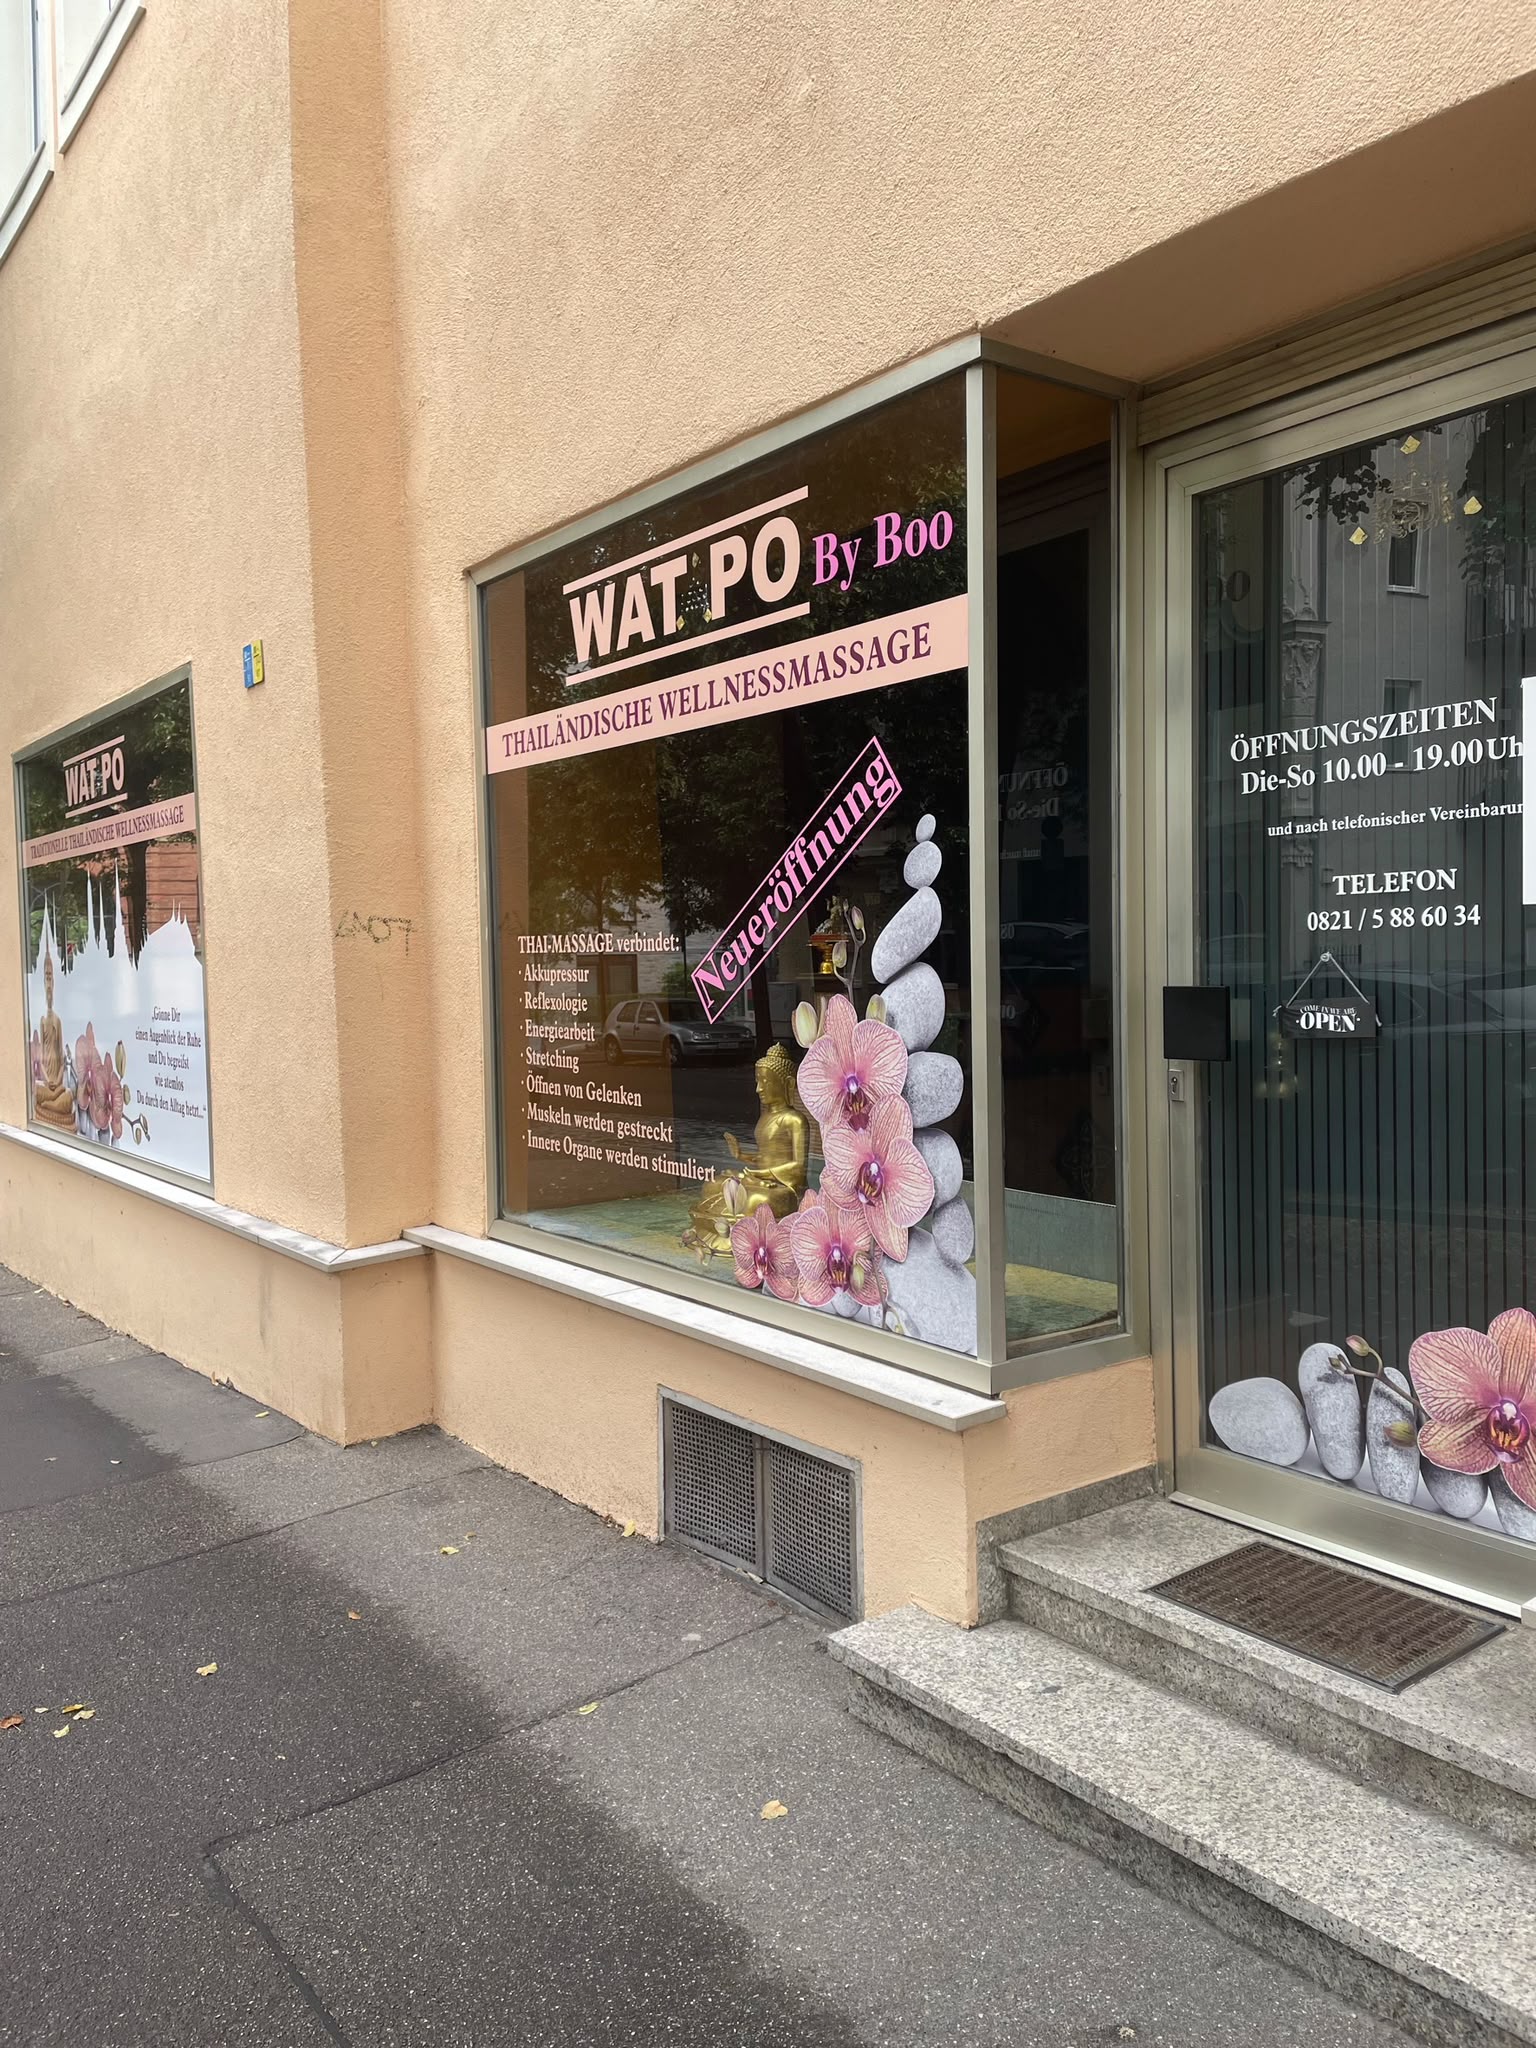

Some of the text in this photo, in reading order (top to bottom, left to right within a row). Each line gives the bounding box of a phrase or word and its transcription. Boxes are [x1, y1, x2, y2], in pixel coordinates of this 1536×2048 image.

[569, 510, 954, 664] WAT PO By Boo
[502, 622, 932, 759] THAILÄNDISCHE WELLNESSMASSAGE
[1230, 697, 1497, 762] ÖFFNUNGSZEITEN
[65, 748, 124, 807] WAT PO
[1241, 736, 1523, 795] Die-So 10.00 - 19.00 Uh
[31, 805, 184, 859] TRADITIONELLE THAILÄNDISCHE WELLNESSMASSAGE
[1268, 802, 1523, 837] und nach telefonischer Vereinbaru
[695, 755, 897, 1009] Neueröffnung
[1332, 869, 1458, 896] TELEFON
[1307, 904, 1481, 931] 0821 / 5 88 60 34
[518, 932, 680, 954] THAI-MASSAGE verbindet:
[524, 964, 589, 985] Akkupressur
[171, 1007, 181, 1022] Dir
[524, 992, 588, 1015] Reflexologie
[525, 1018, 596, 1043] Energiearbeit
[1300, 1012, 1356, 1032] OPEN
[135, 1027, 202, 1047] einen Augenblick der Ruhe
[148, 1050, 190, 1070] und Du begreifst
[525, 1046, 580, 1073] Stretching
[155, 1073, 185, 1092] wie atemlos
[526, 1070, 642, 1107] Öffnen von Gelenken
[136, 1090, 145, 1105] Du
[145, 1092, 159, 1109] durch
[159, 1095, 170, 1110] den
[170, 1098, 186, 1118] Alltag
[526, 1102, 673, 1144] Muskeln werden gestreckt
[527, 1130, 716, 1183] Innere Organe werden stimuliert
